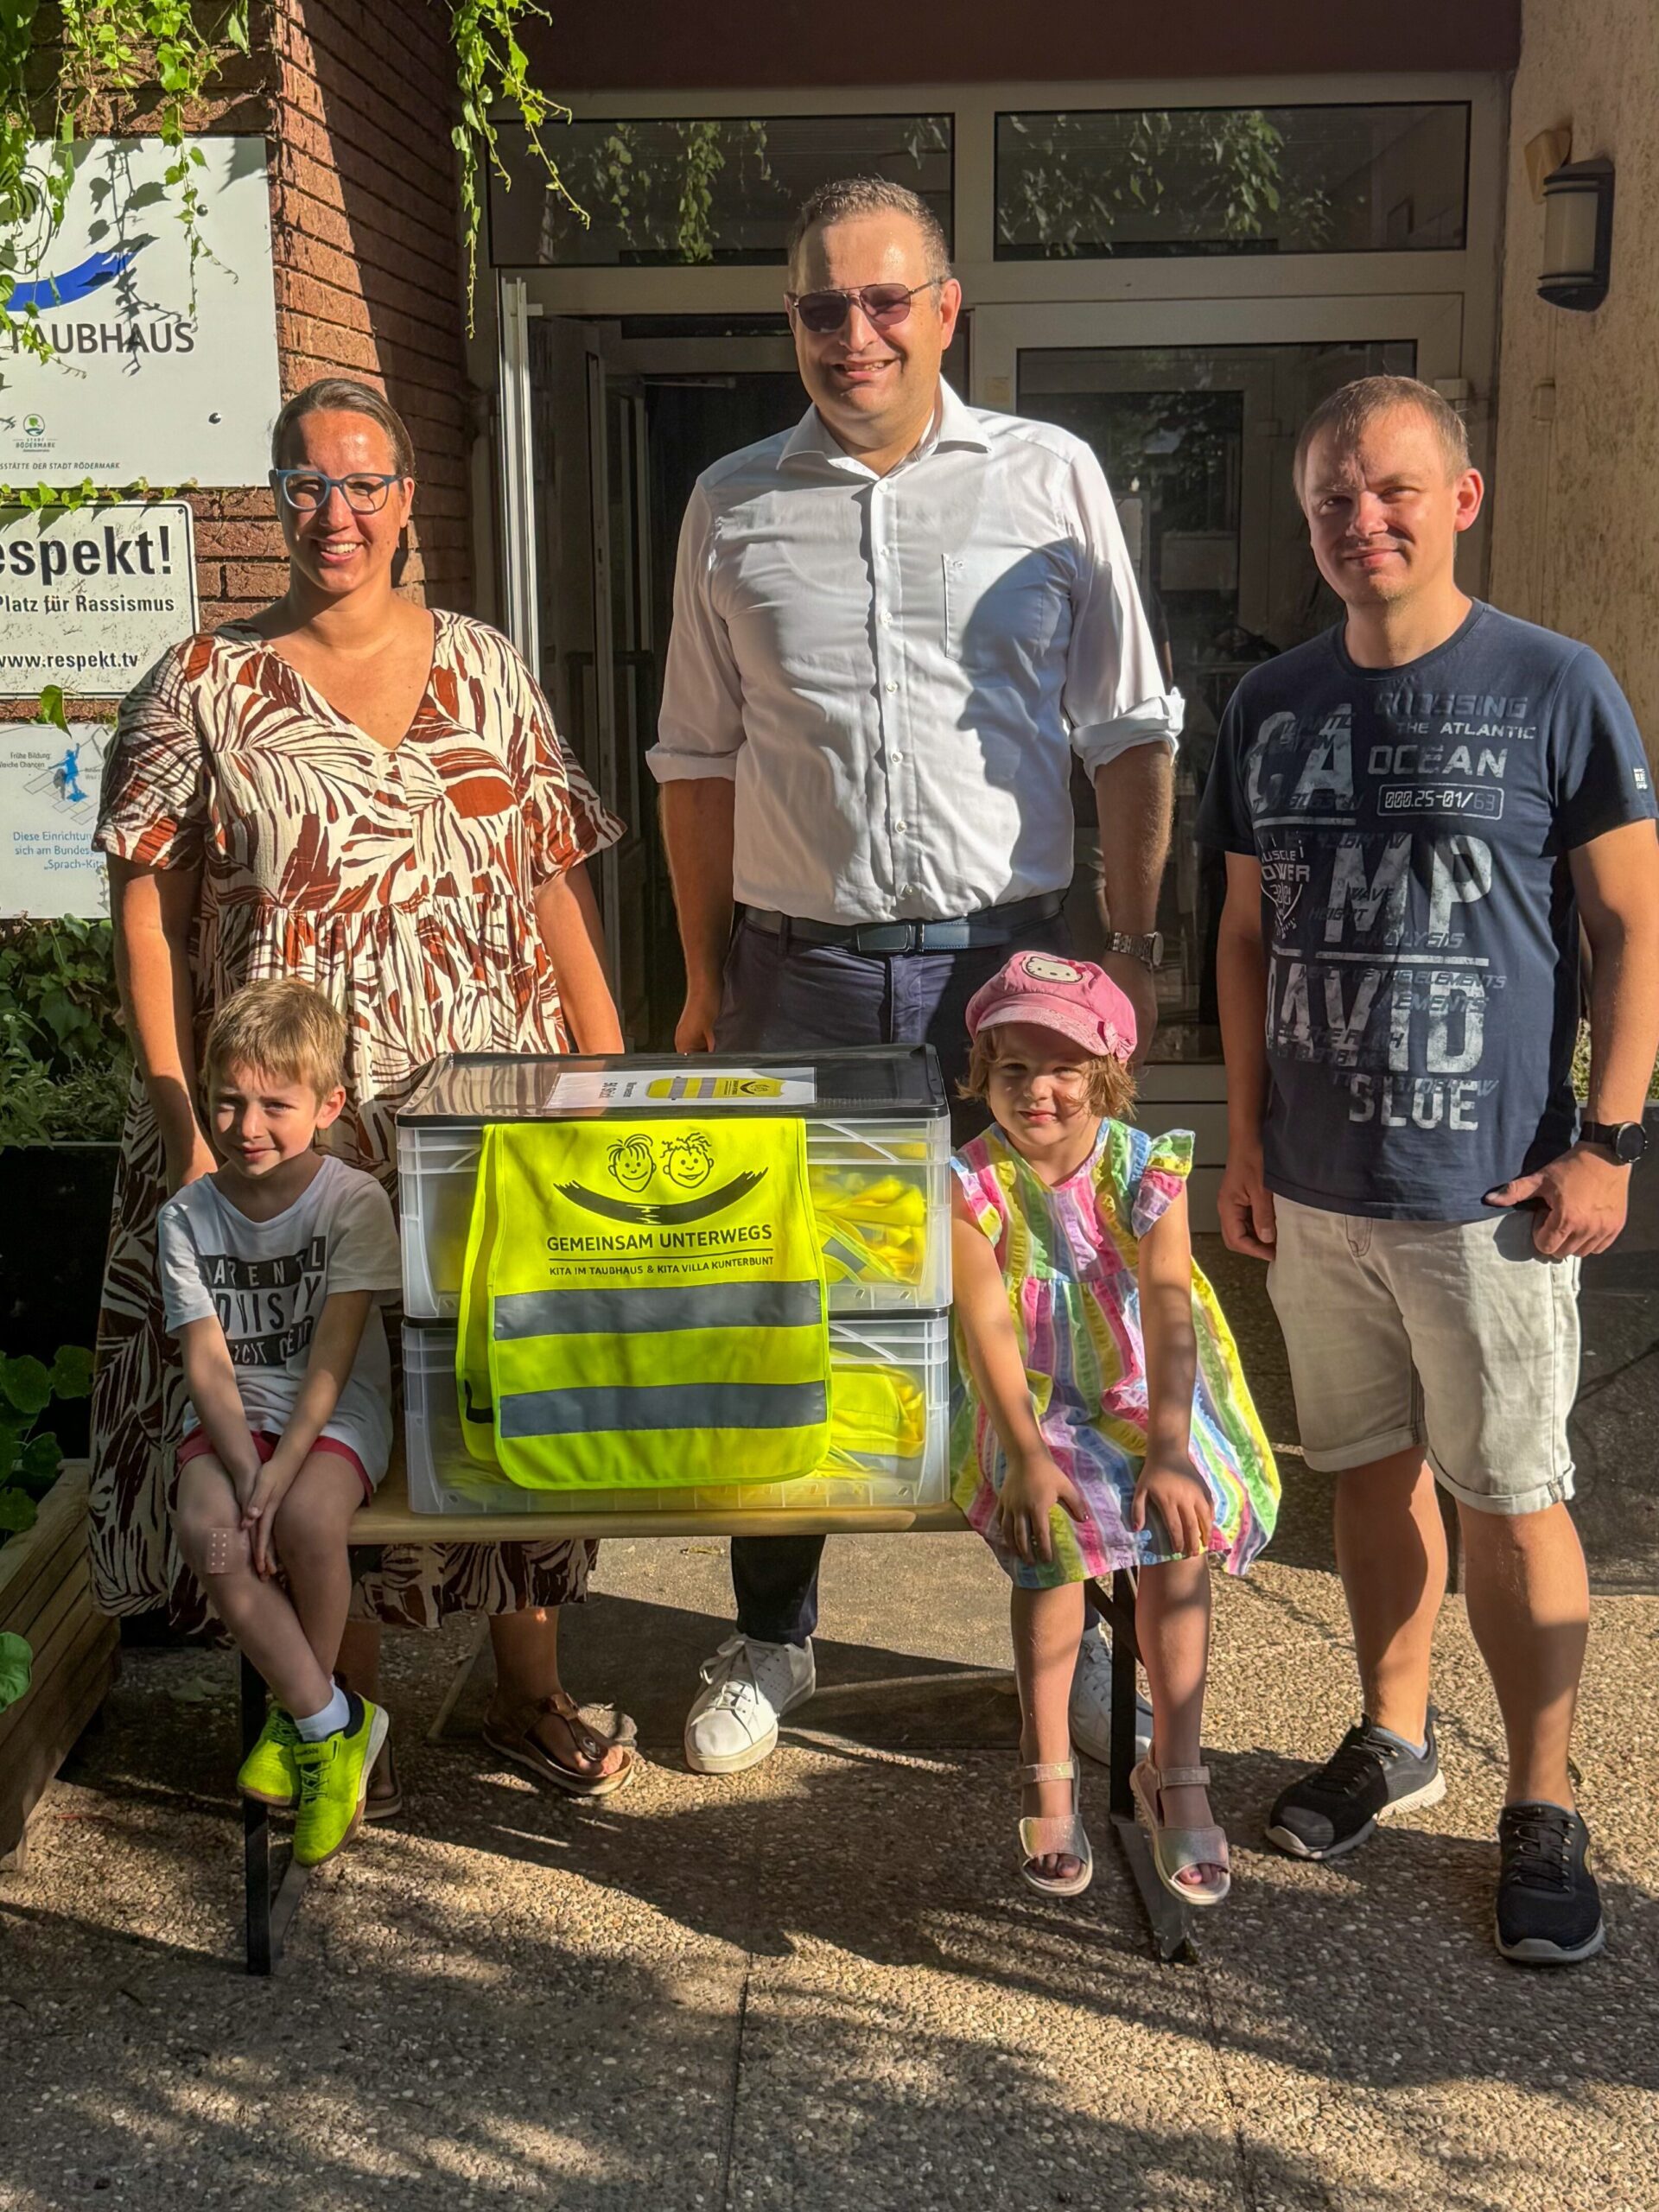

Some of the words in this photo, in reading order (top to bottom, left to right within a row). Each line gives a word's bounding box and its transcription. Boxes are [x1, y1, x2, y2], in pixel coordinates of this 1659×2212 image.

[0, 525, 172, 586] spekt!
[43, 594, 69, 614] für
[76, 594, 175, 612] Rassismus
[1396, 722, 1429, 734] THE
[1440, 721, 1536, 740] ATLANTIC
[1367, 744, 1508, 779] OCEAN
[13, 831, 40, 841] Diese
[15, 845, 34, 855] sich
[546, 1233, 653, 1252] GEMEINSAM
[659, 1224, 772, 1248] UNTERWEGS
[550, 1267, 572, 1275] KITA
[589, 1265, 644, 1275] TAUBHAUS
[646, 1265, 654, 1274] &
[657, 1265, 680, 1274] KITA
[682, 1262, 709, 1273] VILLA
[711, 1256, 774, 1270] KUNTERBUNT
